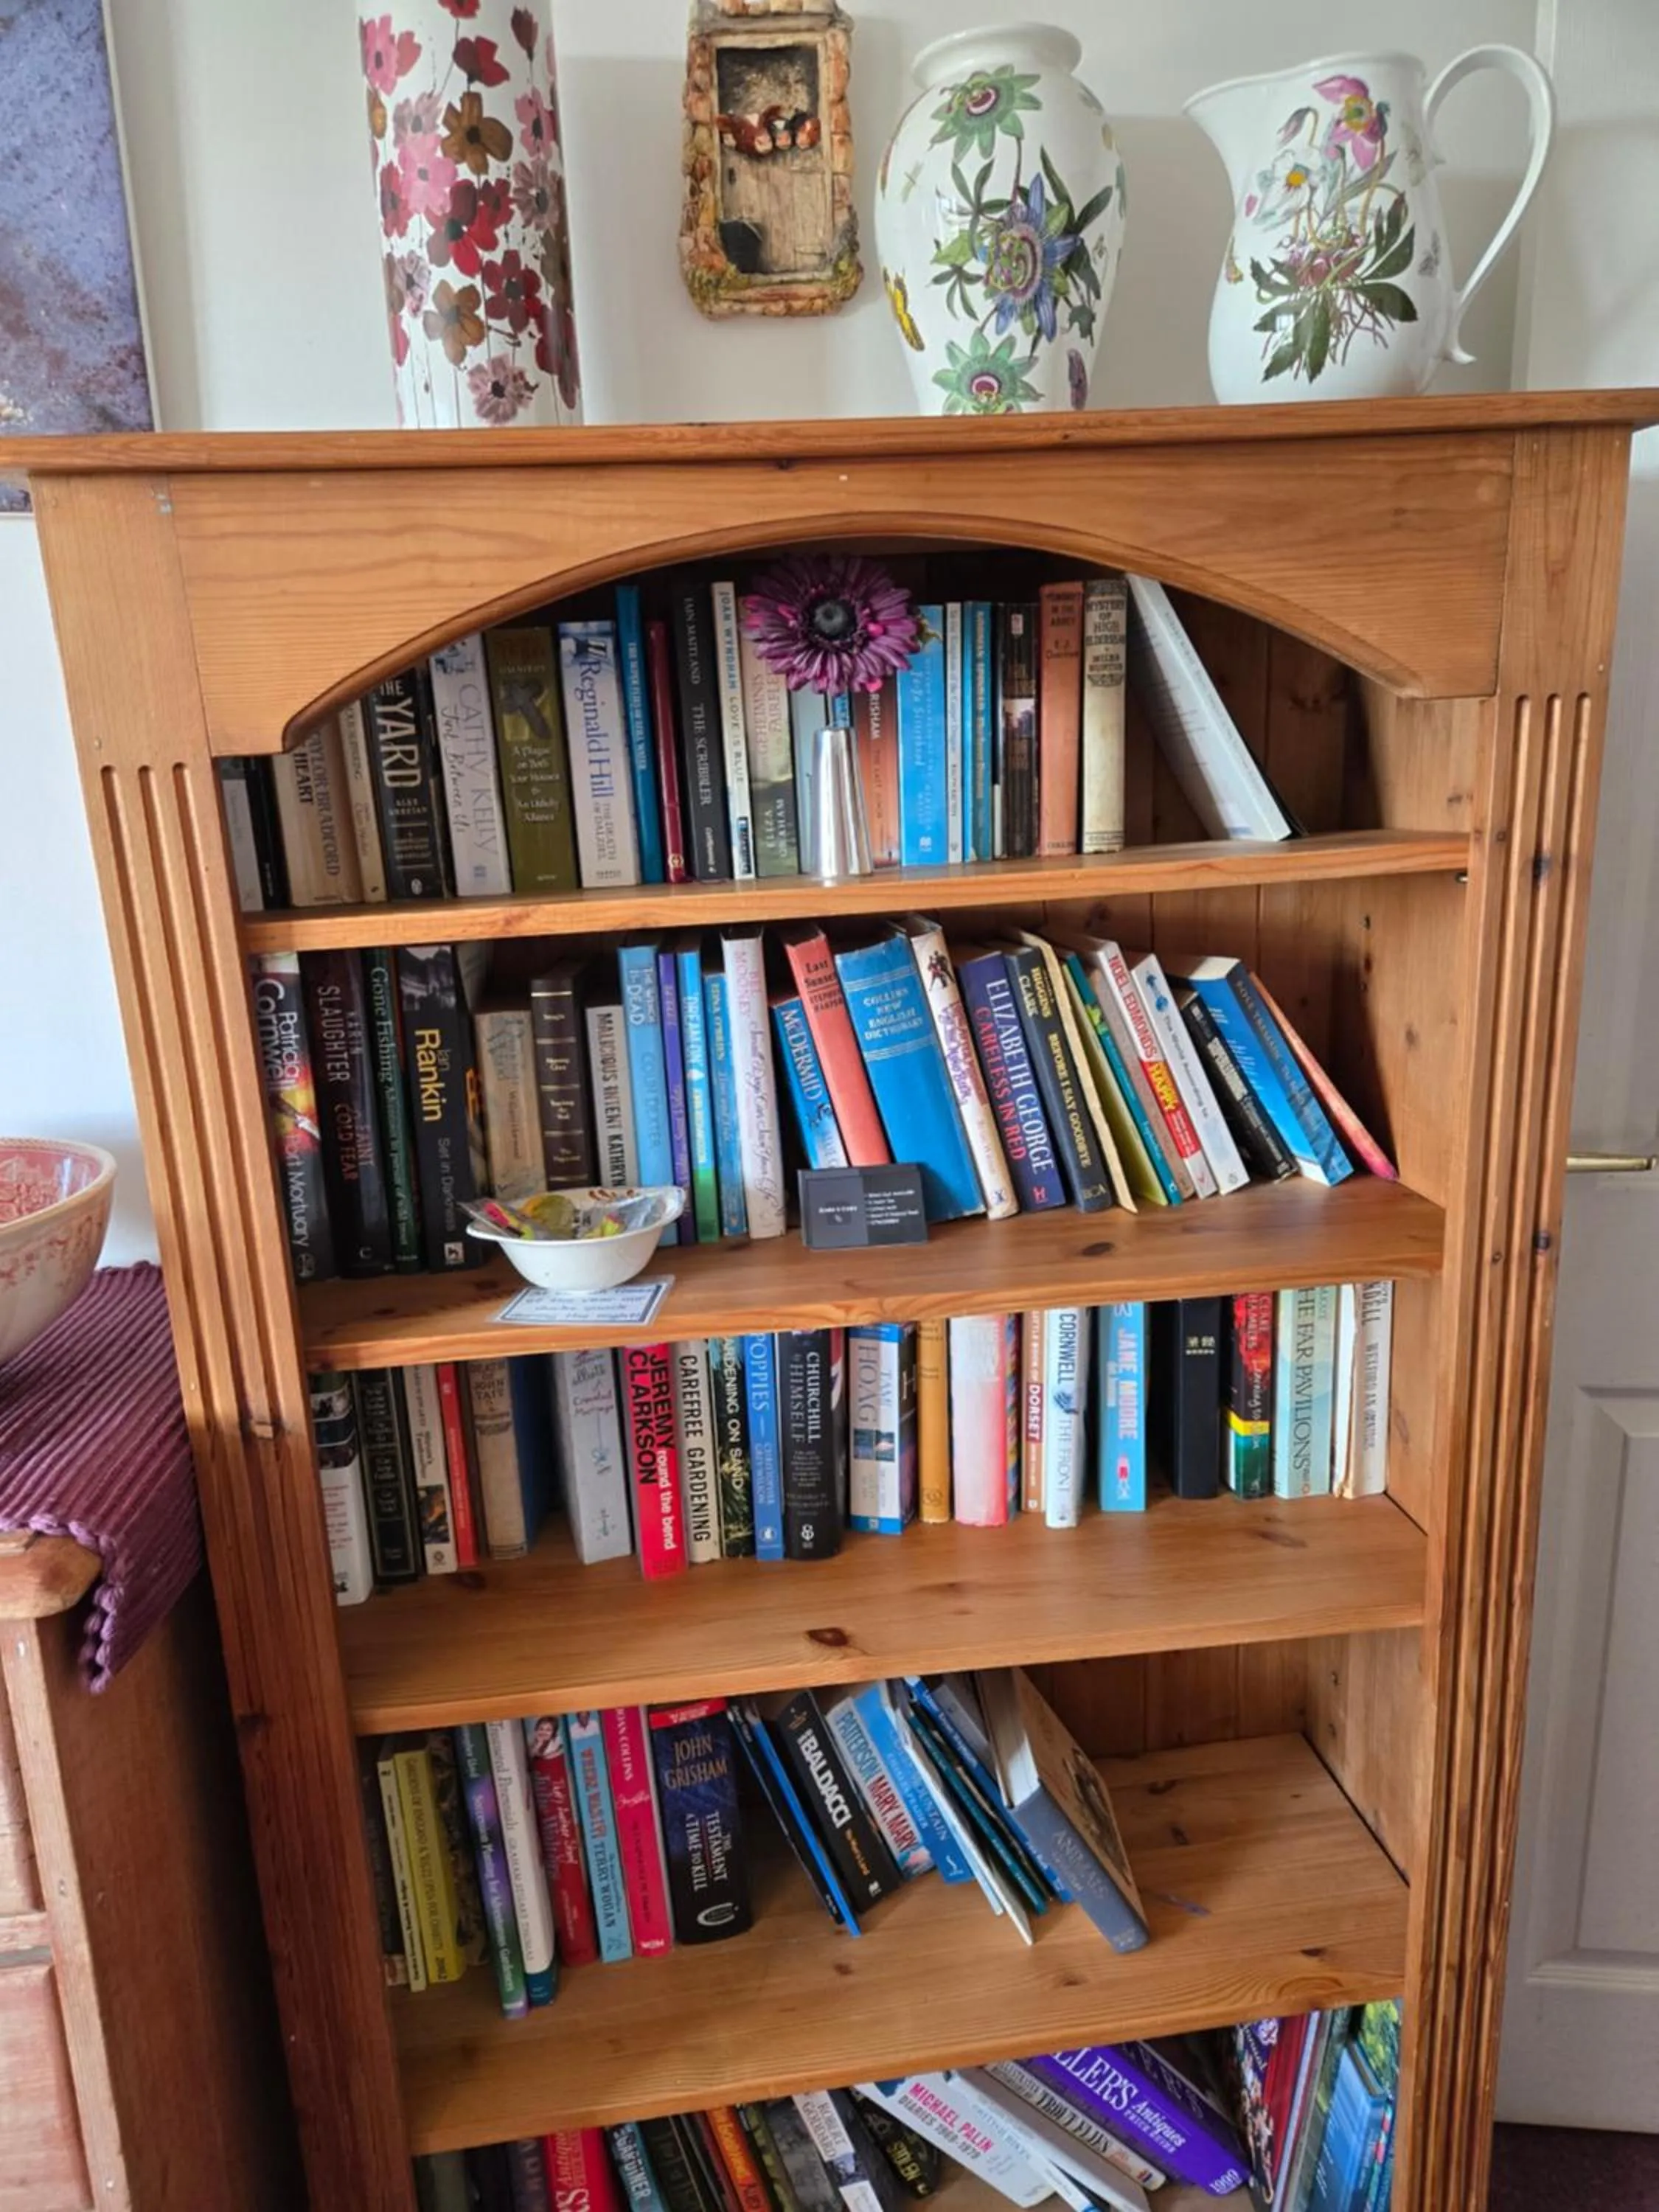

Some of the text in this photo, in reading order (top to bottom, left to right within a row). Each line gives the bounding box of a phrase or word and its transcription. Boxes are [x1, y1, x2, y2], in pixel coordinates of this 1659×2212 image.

[719, 591, 732, 621] JOAN
[685, 625, 702, 684] MAITLAND
[723, 625, 738, 689] WYNDHAM
[380, 680, 405, 696] THE
[692, 704, 706, 733] THE
[869, 692, 883, 740] RISHAM
[374, 697, 422, 788] YARD
[574, 658, 614, 799] Reginald Hill
[294, 751, 313, 804] HEART
[458, 683, 499, 857] CATHY KELLY
[695, 736, 713, 806] SCRIBBLER
[316, 791, 341, 876] BRADFORD
[805, 960, 828, 973] Last
[862, 987, 909, 1007] COLLINS
[1019, 975, 1037, 1018] CLARK
[1032, 966, 1051, 1019] HIGGINS
[256, 978, 295, 1091] Cornwell
[318, 985, 350, 1083] SLAUGHTER
[370, 966, 397, 1083] Gone Fishing
[625, 985, 645, 1026] DEAD
[683, 995, 703, 1039] DREAM
[868, 1007, 916, 1029] ENGLISH
[876, 1000, 902, 1015] NEW
[1108, 956, 1130, 990] NOEL
[1124, 992, 1158, 1059] EDMONDS
[277, 1012, 301, 1079] Patricia
[414, 1028, 448, 1122] Rankin
[434, 1048, 451, 1071] Ian
[781, 1009, 824, 1102] McDERMID
[985, 978, 1055, 1174] ELIZABETH GEORGE
[1048, 1034, 1068, 1079] BEFORE
[596, 1012, 629, 1188] MALICIOUS INTENT KATHRYN
[974, 1006, 1027, 1161] CARELESS IN RED
[1062, 1088, 1077, 1111] SAY
[333, 1103, 359, 1181] COLD FEAR
[437, 1138, 451, 1160] Set
[1068, 1114, 1092, 1169] GOODBYE
[285, 1133, 310, 1248] Port Mortuary
[475, 1378, 505, 1391] JOHN
[749, 1332, 770, 1411] POPPIES
[790, 1363, 807, 1444] HIMSELF
[806, 1351, 822, 1444] CHURCHILL
[858, 1345, 878, 1425] HOAG
[1057, 1312, 1077, 1492] CORNWELL THE FRONT
[1116, 1327, 1138, 1440] JANE MOORE
[1293, 1288, 1315, 1471] HE FAR PAVILIONS
[627, 1349, 659, 1486] CLARKSON
[722, 1338, 746, 1490] ARDENING ON SAND
[1027, 1384, 1042, 1441] DORSET
[649, 1354, 677, 1551] JEREMY round the bend
[678, 1354, 712, 1543] CAREFREE GARDENING
[664, 1758, 728, 1790] GRISHAM
[675, 1733, 714, 1765] JOHN
[836, 1711, 883, 1783] PATTERSON
[801, 1736, 853, 1829] BALDACCI
[867, 1774, 919, 1851] MARY, MARY
[593, 1841, 608, 1879] TERRY
[687, 1820, 703, 1852] TIME
[706, 1811, 728, 1881] TESTAMENT
[599, 1882, 616, 1927] WOGAN
[691, 1865, 709, 1893] KILL
[897, 2095, 936, 2126] DIARIES
[1051, 2047, 1139, 2111] LLER'S
[802, 2104, 838, 2157] GODDARD
[817, 2101, 846, 2146] ROBERT
[908, 2081, 957, 2127] MICHAEL
[958, 2119, 995, 2154] PALIN
[1131, 2100, 1187, 2148] Antiques
[616, 2138, 653, 2201] GARDINER
